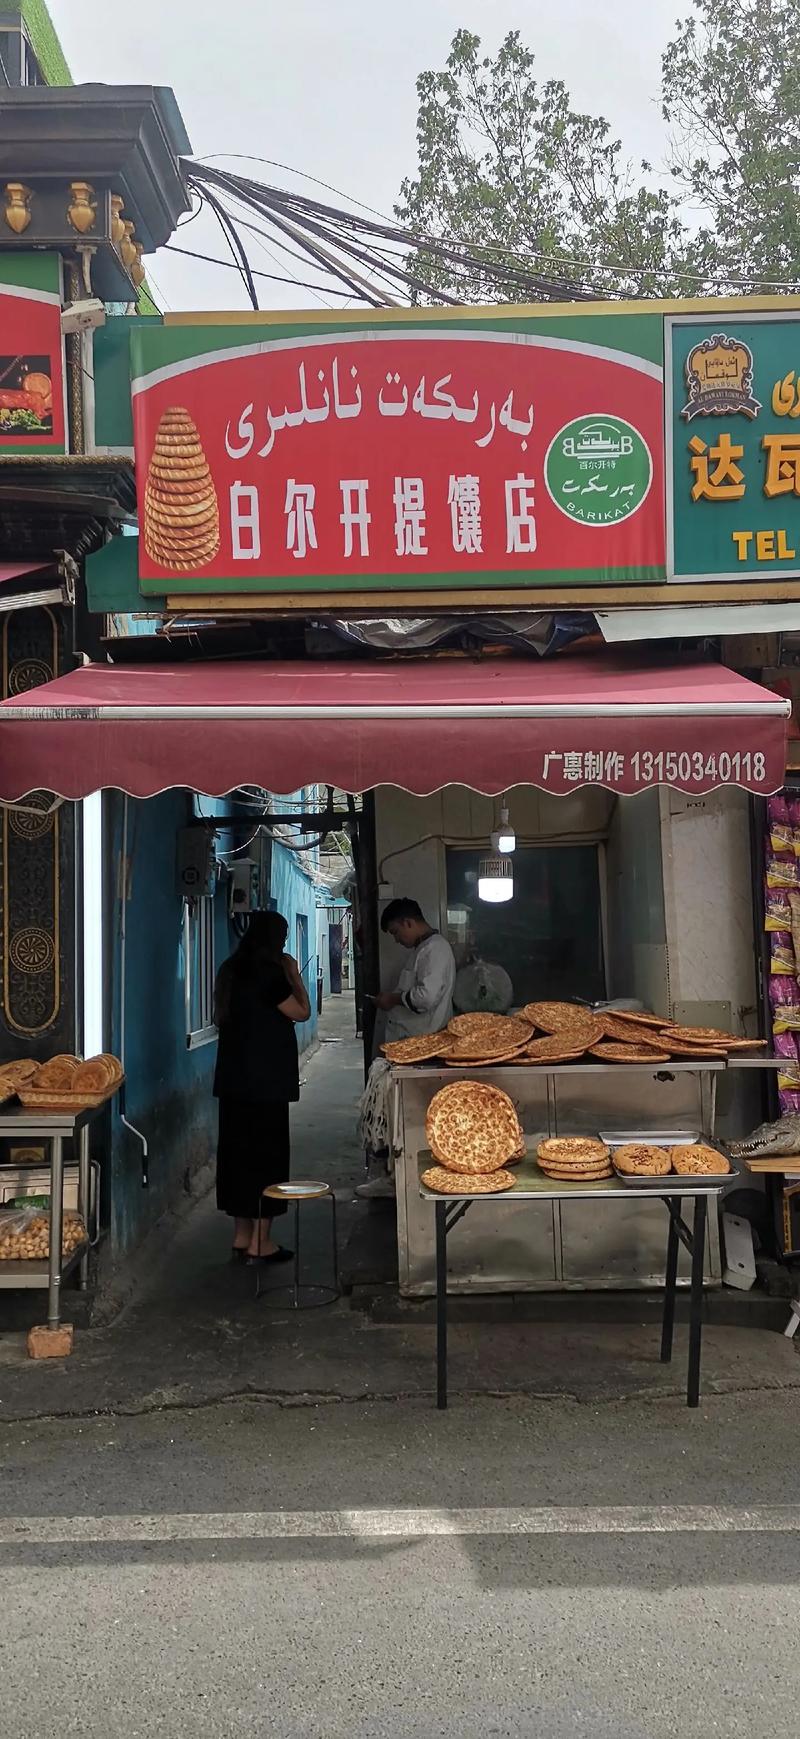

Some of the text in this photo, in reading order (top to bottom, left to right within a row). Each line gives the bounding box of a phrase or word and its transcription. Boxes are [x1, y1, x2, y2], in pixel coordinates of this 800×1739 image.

[566, 501, 631, 521] BARIKAT
[732, 530, 795, 561] TEL
[543, 751, 766, 782] 广惠制作 13150340118
